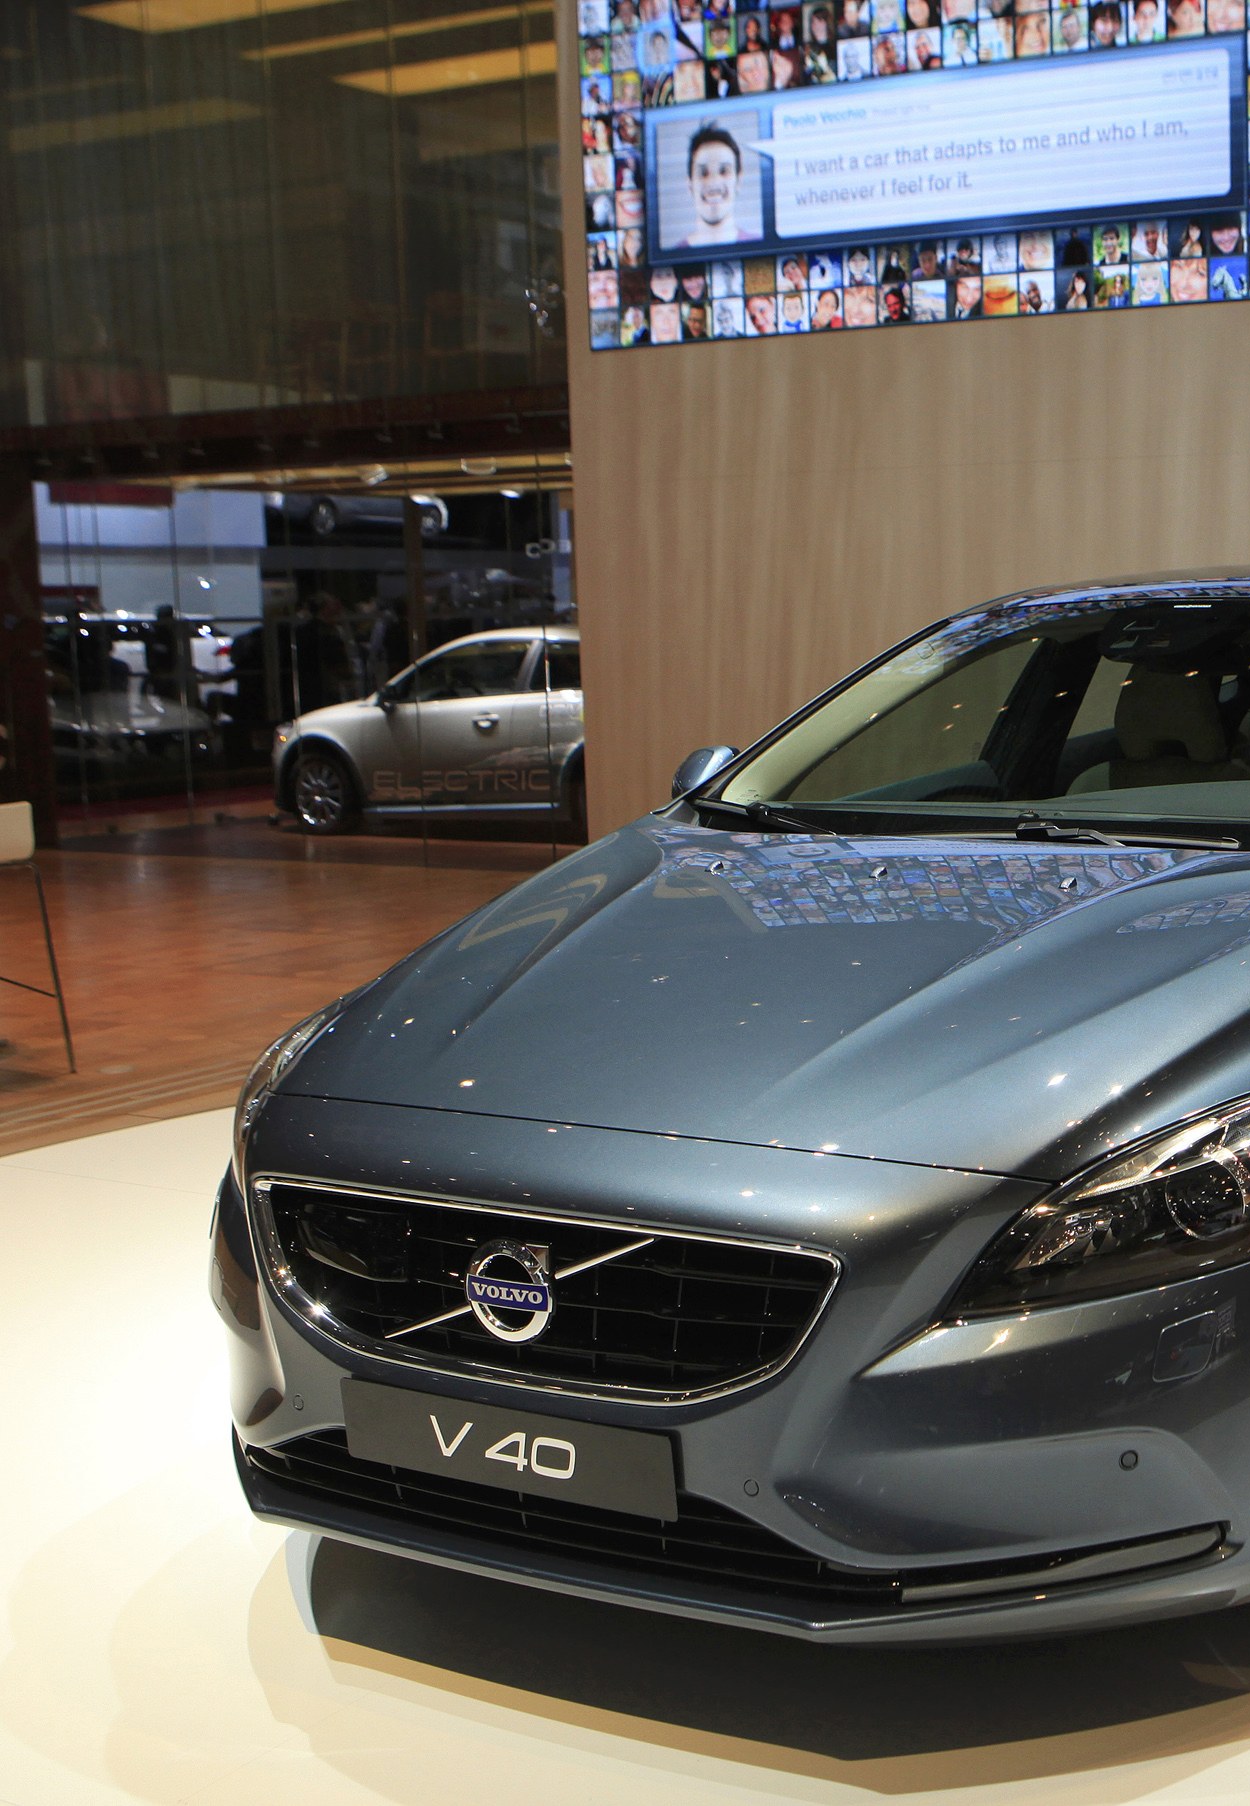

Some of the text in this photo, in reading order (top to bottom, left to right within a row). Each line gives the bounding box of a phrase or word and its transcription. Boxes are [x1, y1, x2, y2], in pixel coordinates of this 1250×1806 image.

[804, 155, 845, 176] want
[848, 157, 860, 171] a
[863, 152, 890, 169] car
[895, 146, 929, 166] that
[933, 138, 994, 161] adapts
[998, 135, 1017, 154] to
[1022, 134, 1051, 152] me
[1056, 126, 1091, 147] and
[1095, 122, 1136, 143] who
[1153, 119, 1189, 139] am,
[795, 182, 876, 207] whenever
[891, 175, 924, 196] feel
[927, 172, 953, 192] for
[956, 170, 973, 189] it.
[373, 769, 550, 792] ELECTRIC
[471, 1281, 543, 1305] VOLVO
[429, 1414, 577, 1480] V 40
